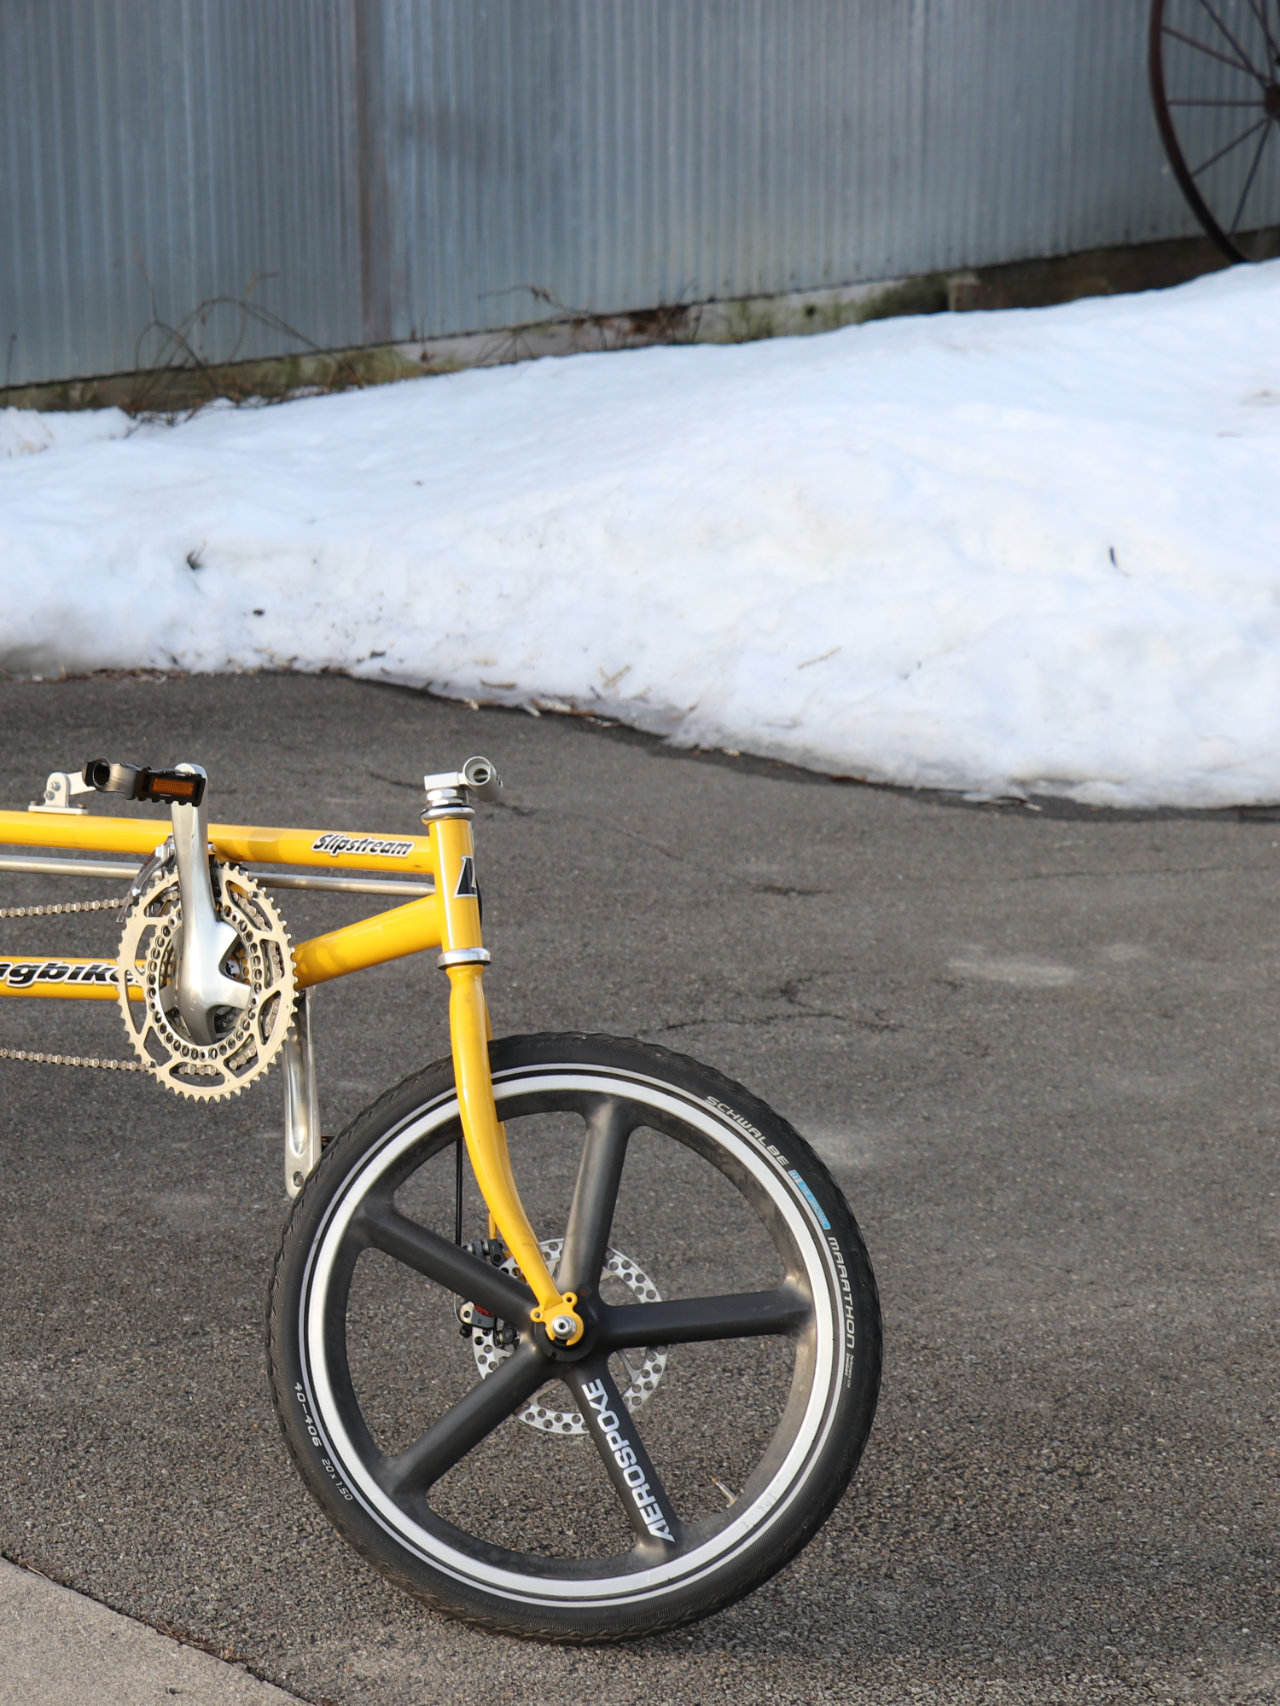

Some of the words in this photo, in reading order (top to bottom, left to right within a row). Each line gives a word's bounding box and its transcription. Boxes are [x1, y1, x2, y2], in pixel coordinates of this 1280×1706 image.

[312, 833, 414, 856] Slipstream
[704, 1096, 789, 1167] SCHWALBE
[828, 1236, 855, 1349] MARATHON
[295, 1382, 322, 1447] 40-406
[581, 1378, 676, 1543] AEROSPOKE
